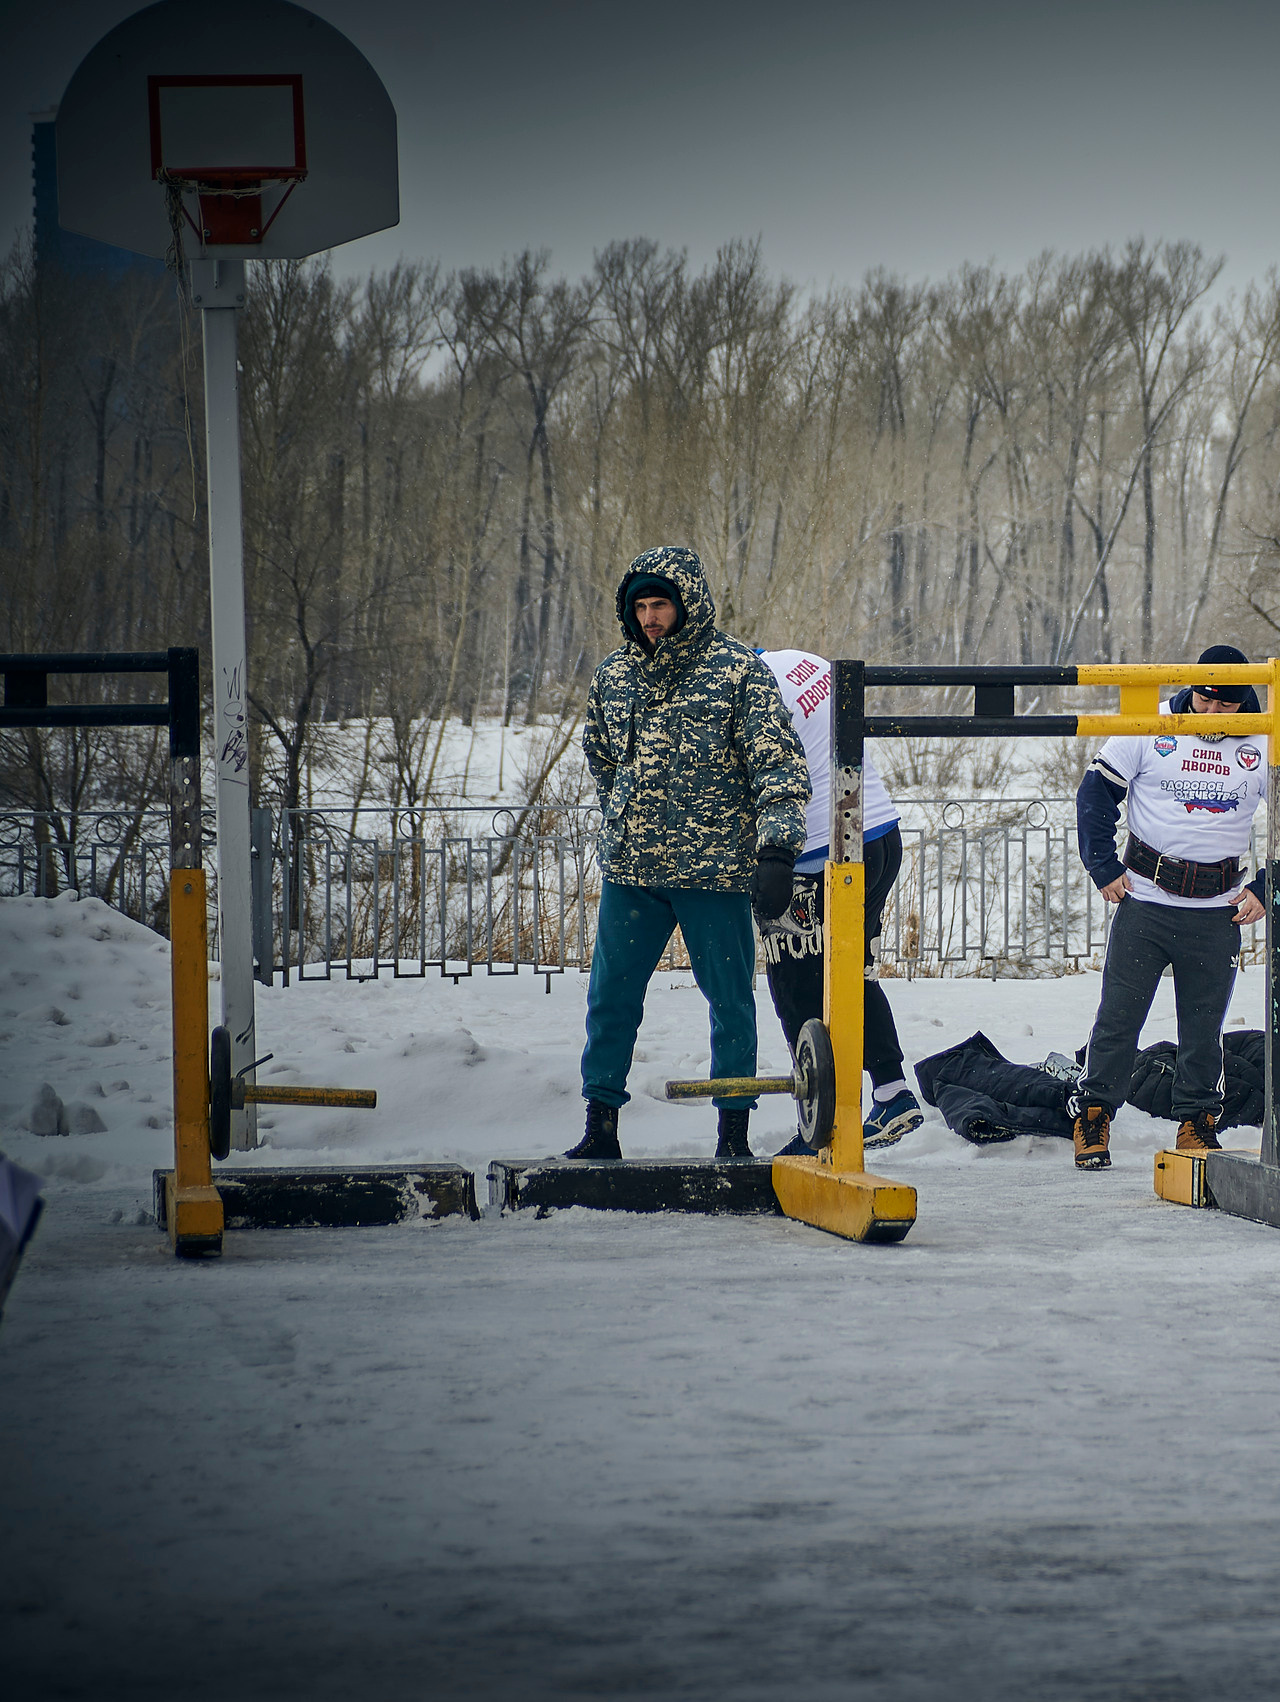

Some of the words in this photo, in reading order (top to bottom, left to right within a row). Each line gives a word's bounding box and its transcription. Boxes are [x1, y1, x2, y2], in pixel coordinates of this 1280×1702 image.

[785, 658, 820, 687] СИЛА
[796, 670, 831, 719] ДВОРО
[1192, 748, 1222, 761] СИЛА
[1181, 759, 1230, 776] ДВОРОВ
[1160, 779, 1224, 792] ЗДОРОВОЕ
[1174, 789, 1239, 801] ОТЕЧЕСТВО
